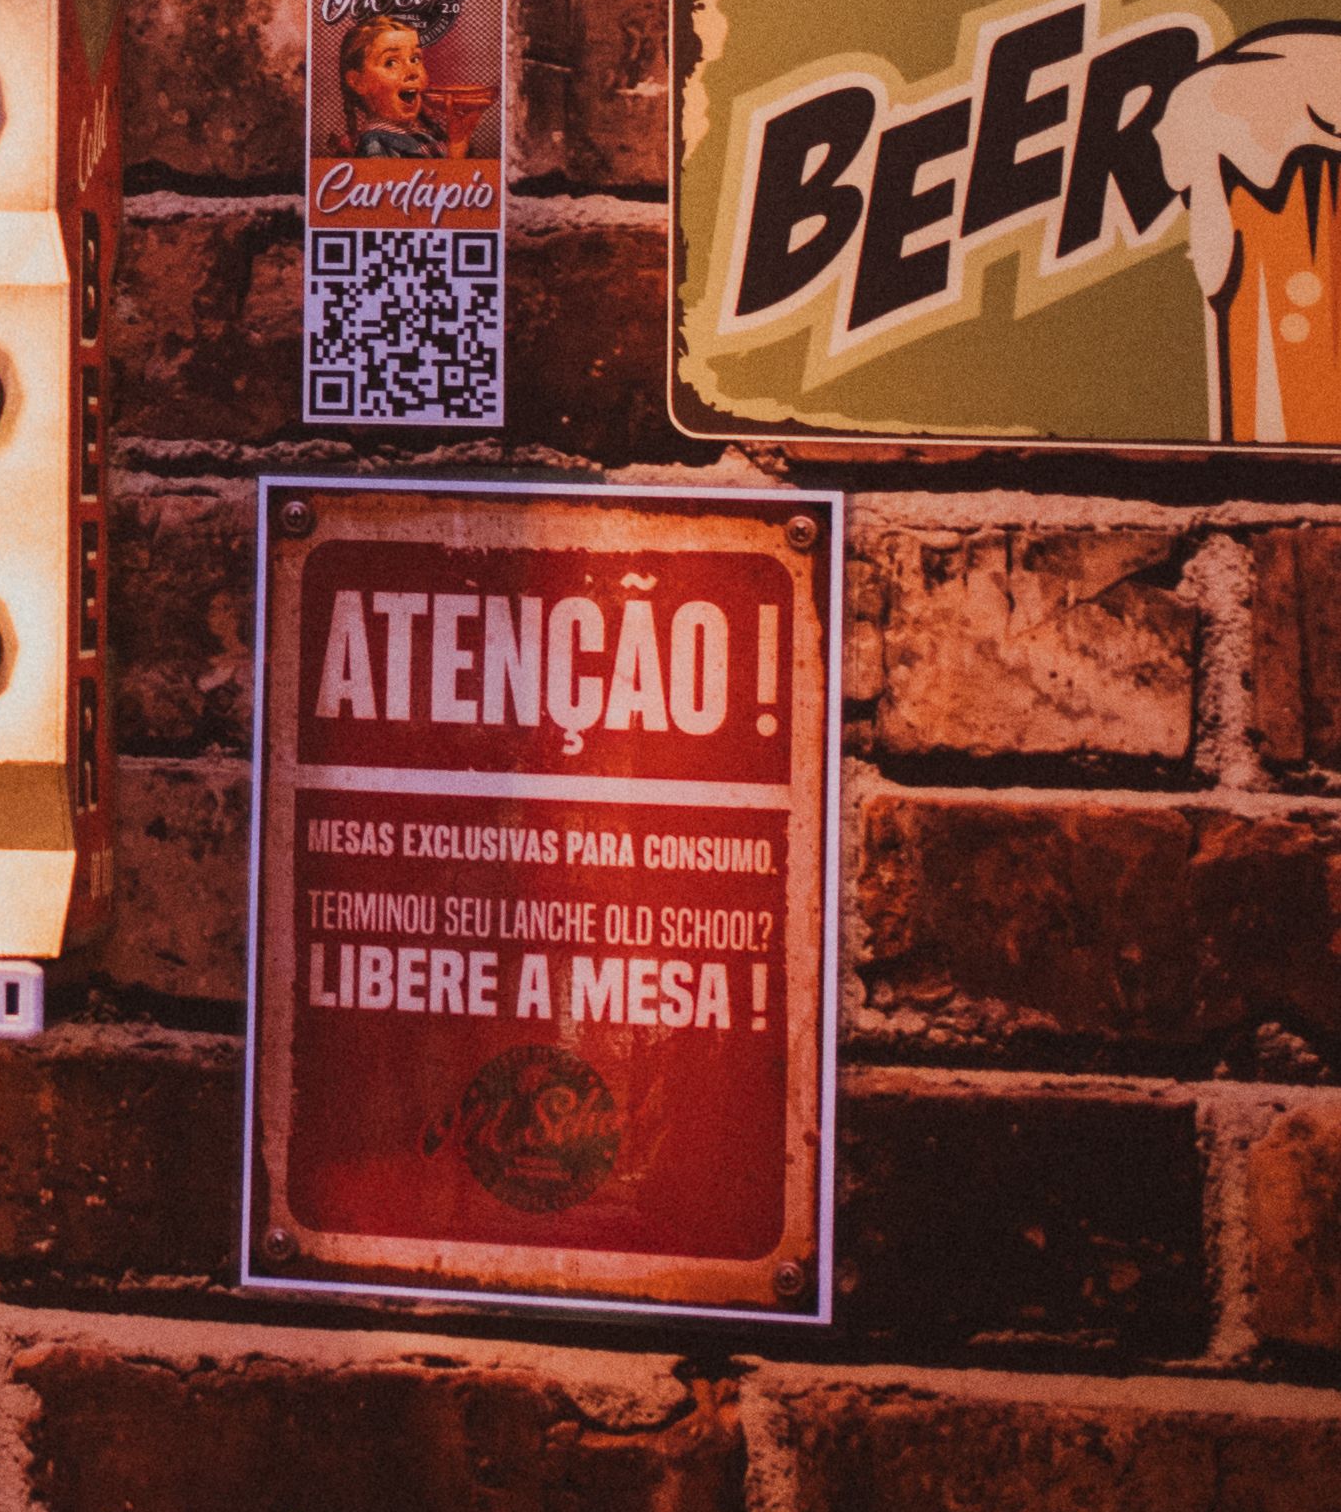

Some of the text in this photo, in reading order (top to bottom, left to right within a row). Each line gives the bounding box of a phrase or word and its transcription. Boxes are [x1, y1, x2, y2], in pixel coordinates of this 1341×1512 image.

[441, 3, 461, 14] 2.0
[315, 160, 495, 225] Cardápio
[731, 1, 1203, 336] BEER
[315, 571, 780, 756] ATENÇÃO !
[307, 820, 779, 876] MESAS EXCLUSIVAS PARA CONSUMO.
[308, 890, 774, 954] TERMINOU SEU LANCHE OLD SCHOOL?
[309, 944, 769, 1033] LIBERE A MESA !
